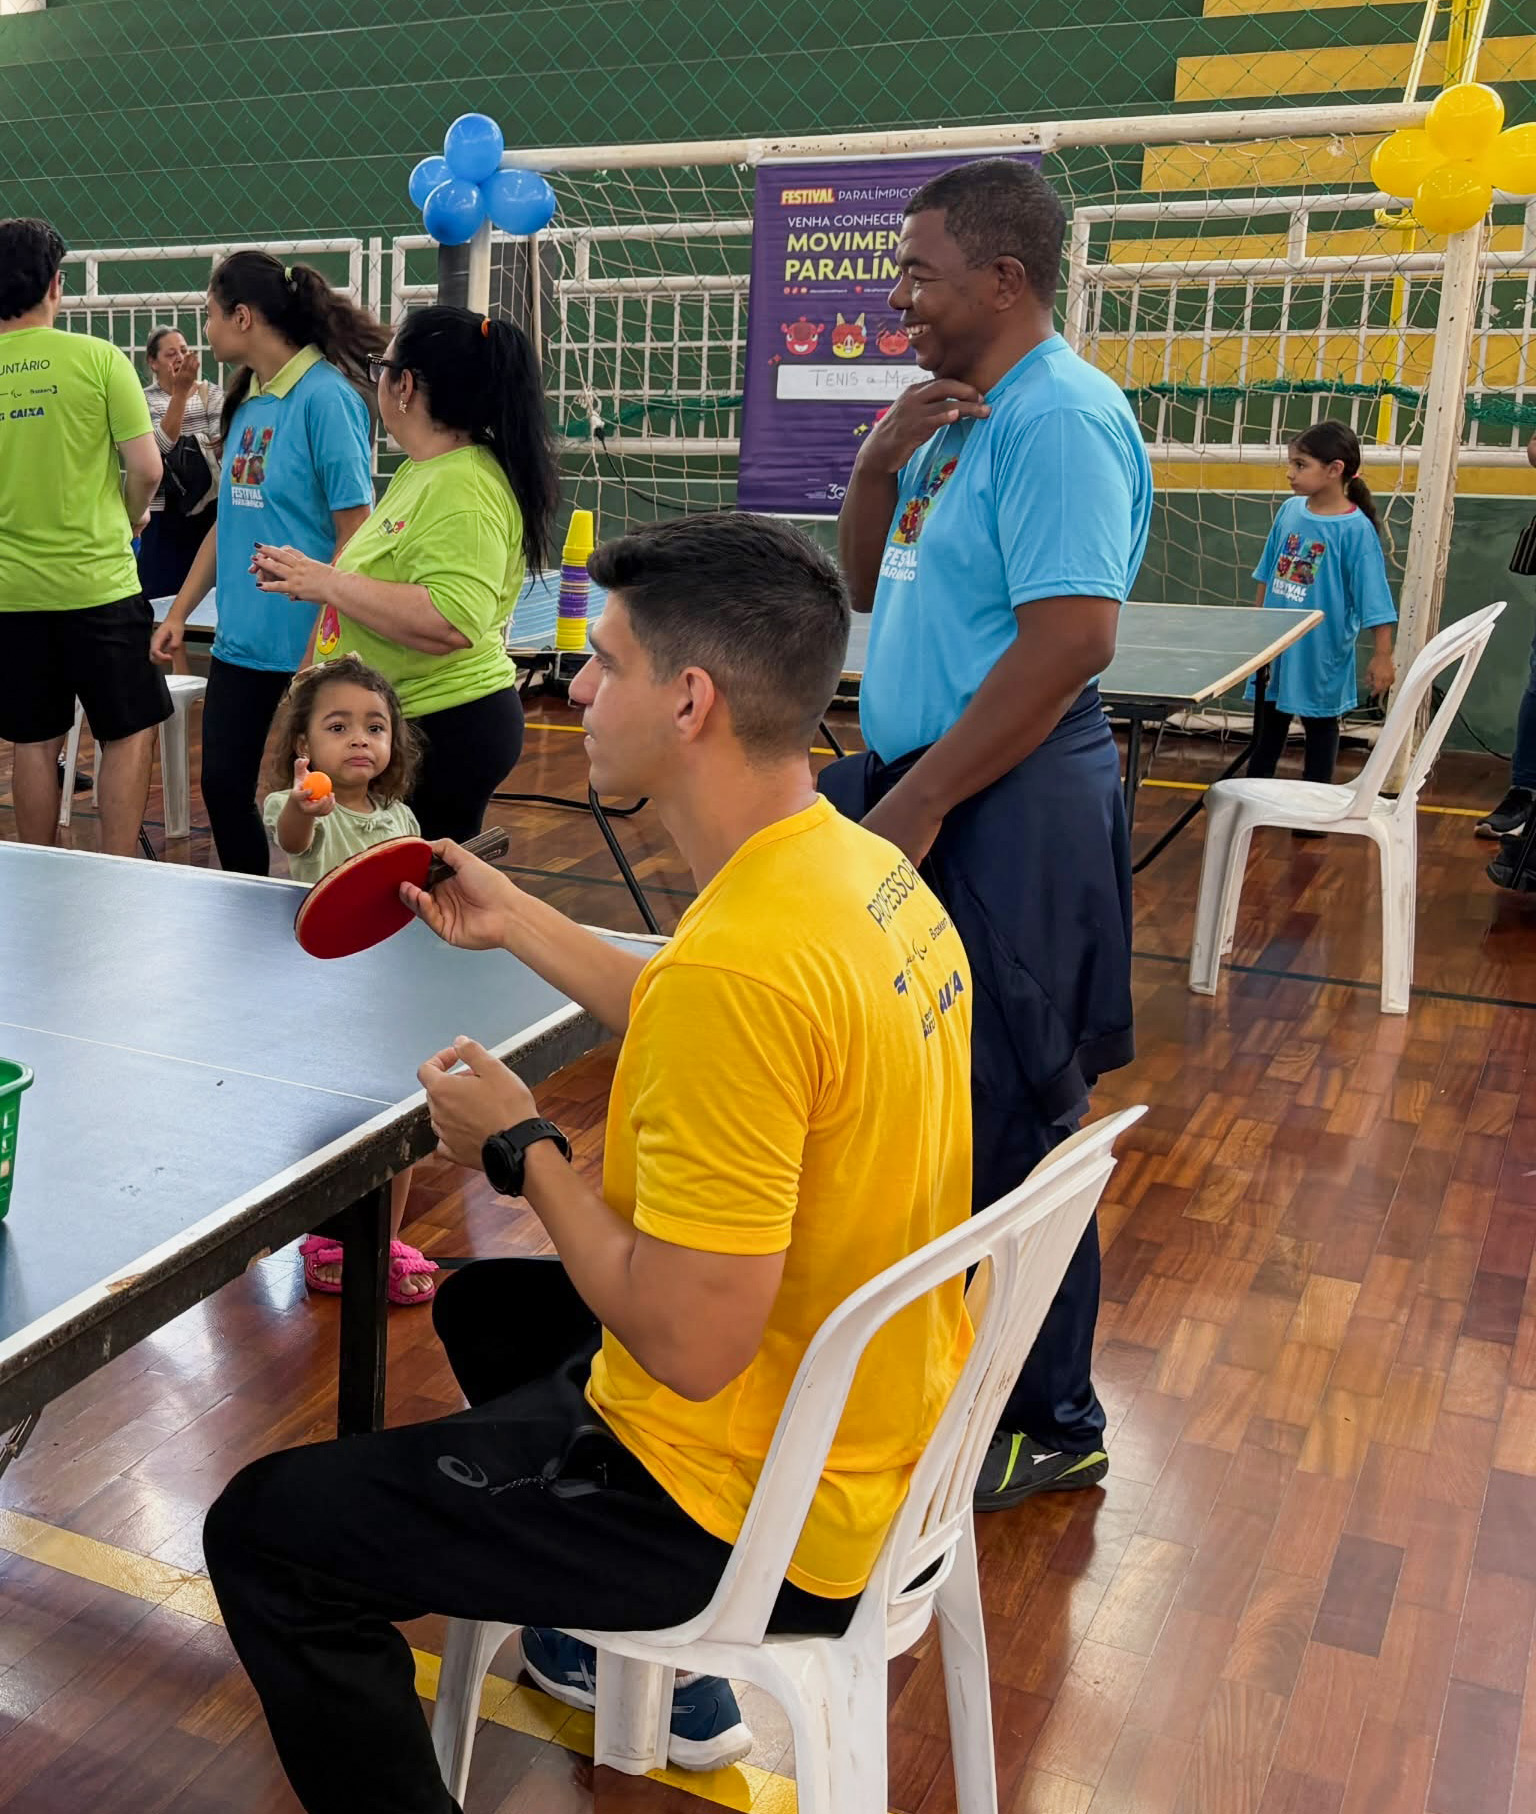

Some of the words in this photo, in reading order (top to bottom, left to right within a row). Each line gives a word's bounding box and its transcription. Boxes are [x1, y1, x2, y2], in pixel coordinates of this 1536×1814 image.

[781, 187, 835, 205] FESTIVAL
[788, 216, 830, 228] VENHA
[833, 213, 905, 227] CONHECER
[787, 230, 902, 252] MOVIMEN
[785, 250, 901, 281] PARALÍM
[808, 369, 859, 387] TENIS
[10, 407, 45, 419] CAIXA
[232, 487, 262, 499] FESTIVAL
[866, 858, 921, 933] PROFESSOR
